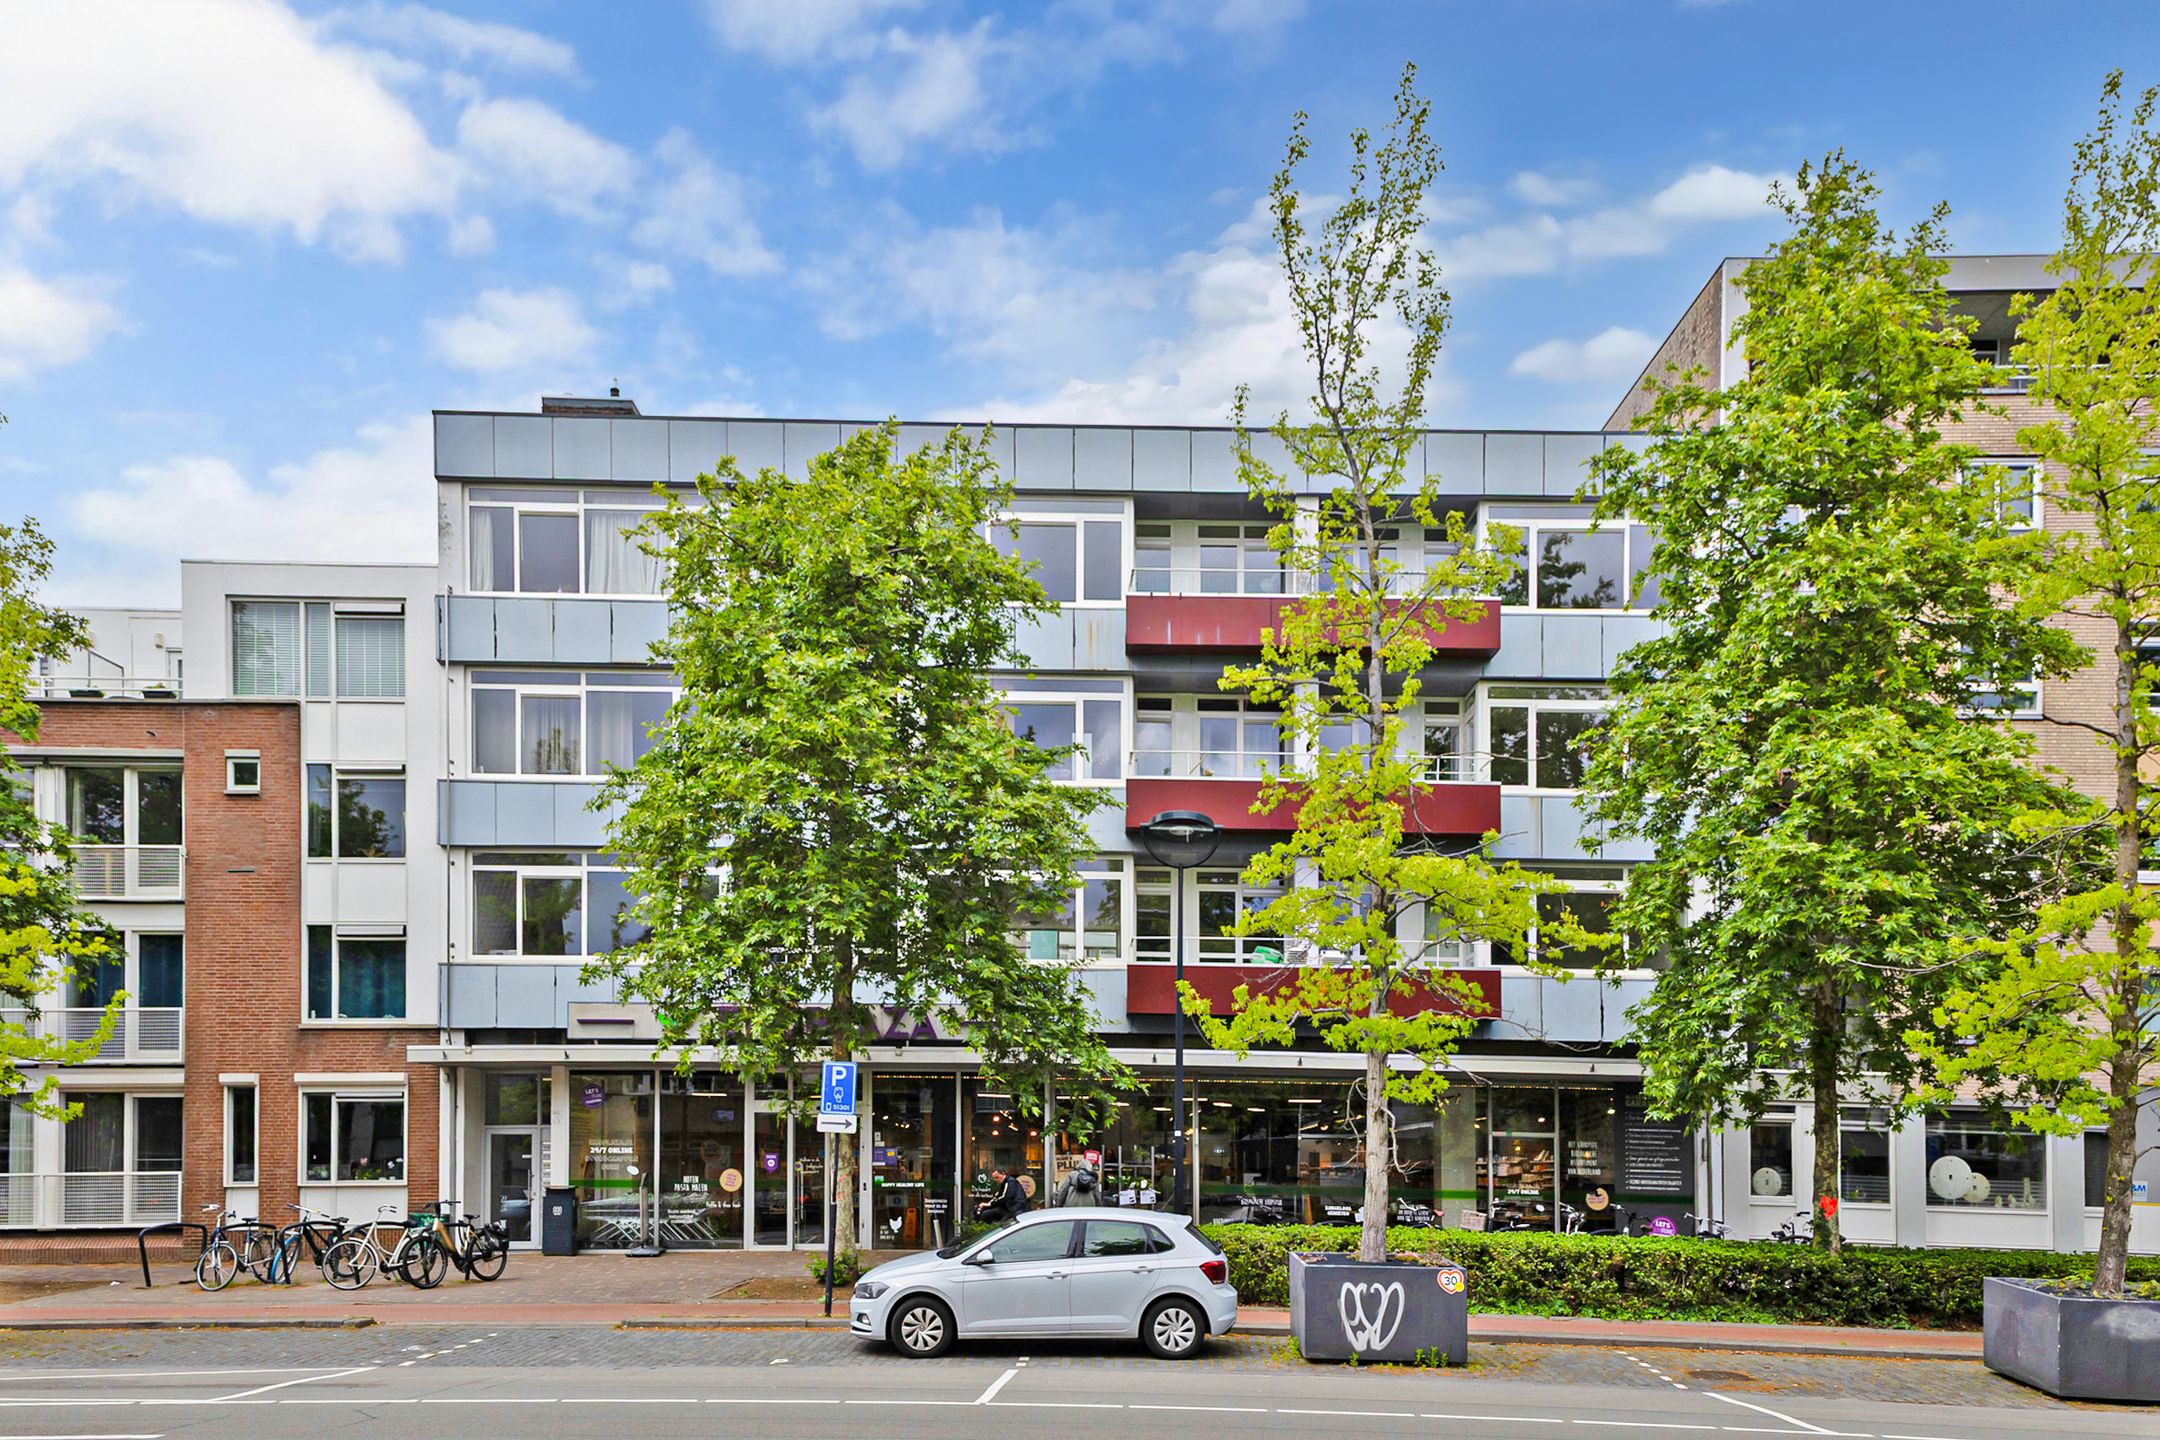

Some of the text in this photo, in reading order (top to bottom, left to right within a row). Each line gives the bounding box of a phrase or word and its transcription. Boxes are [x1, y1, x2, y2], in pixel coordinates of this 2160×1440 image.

[831, 1066, 847, 1087] P
[683, 1175, 699, 1183] NOTEN
[674, 1183, 690, 1191] PASTA
[1444, 1276, 1458, 1286] 30
